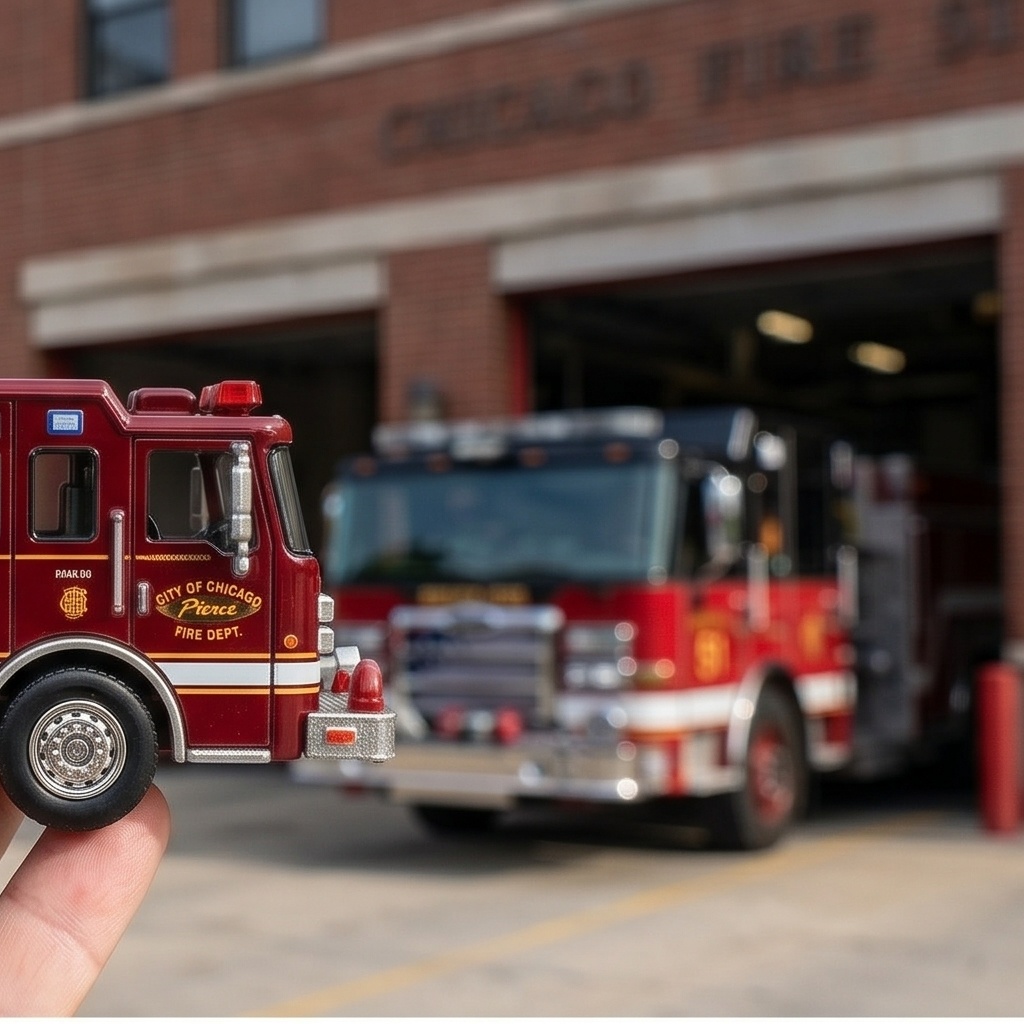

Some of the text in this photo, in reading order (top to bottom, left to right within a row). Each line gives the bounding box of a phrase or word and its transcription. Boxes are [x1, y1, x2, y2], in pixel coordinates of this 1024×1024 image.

[186, 581, 203, 594] OF
[177, 598, 238, 618] Pierce
[175, 626, 243, 640] FIRE DEPT.
